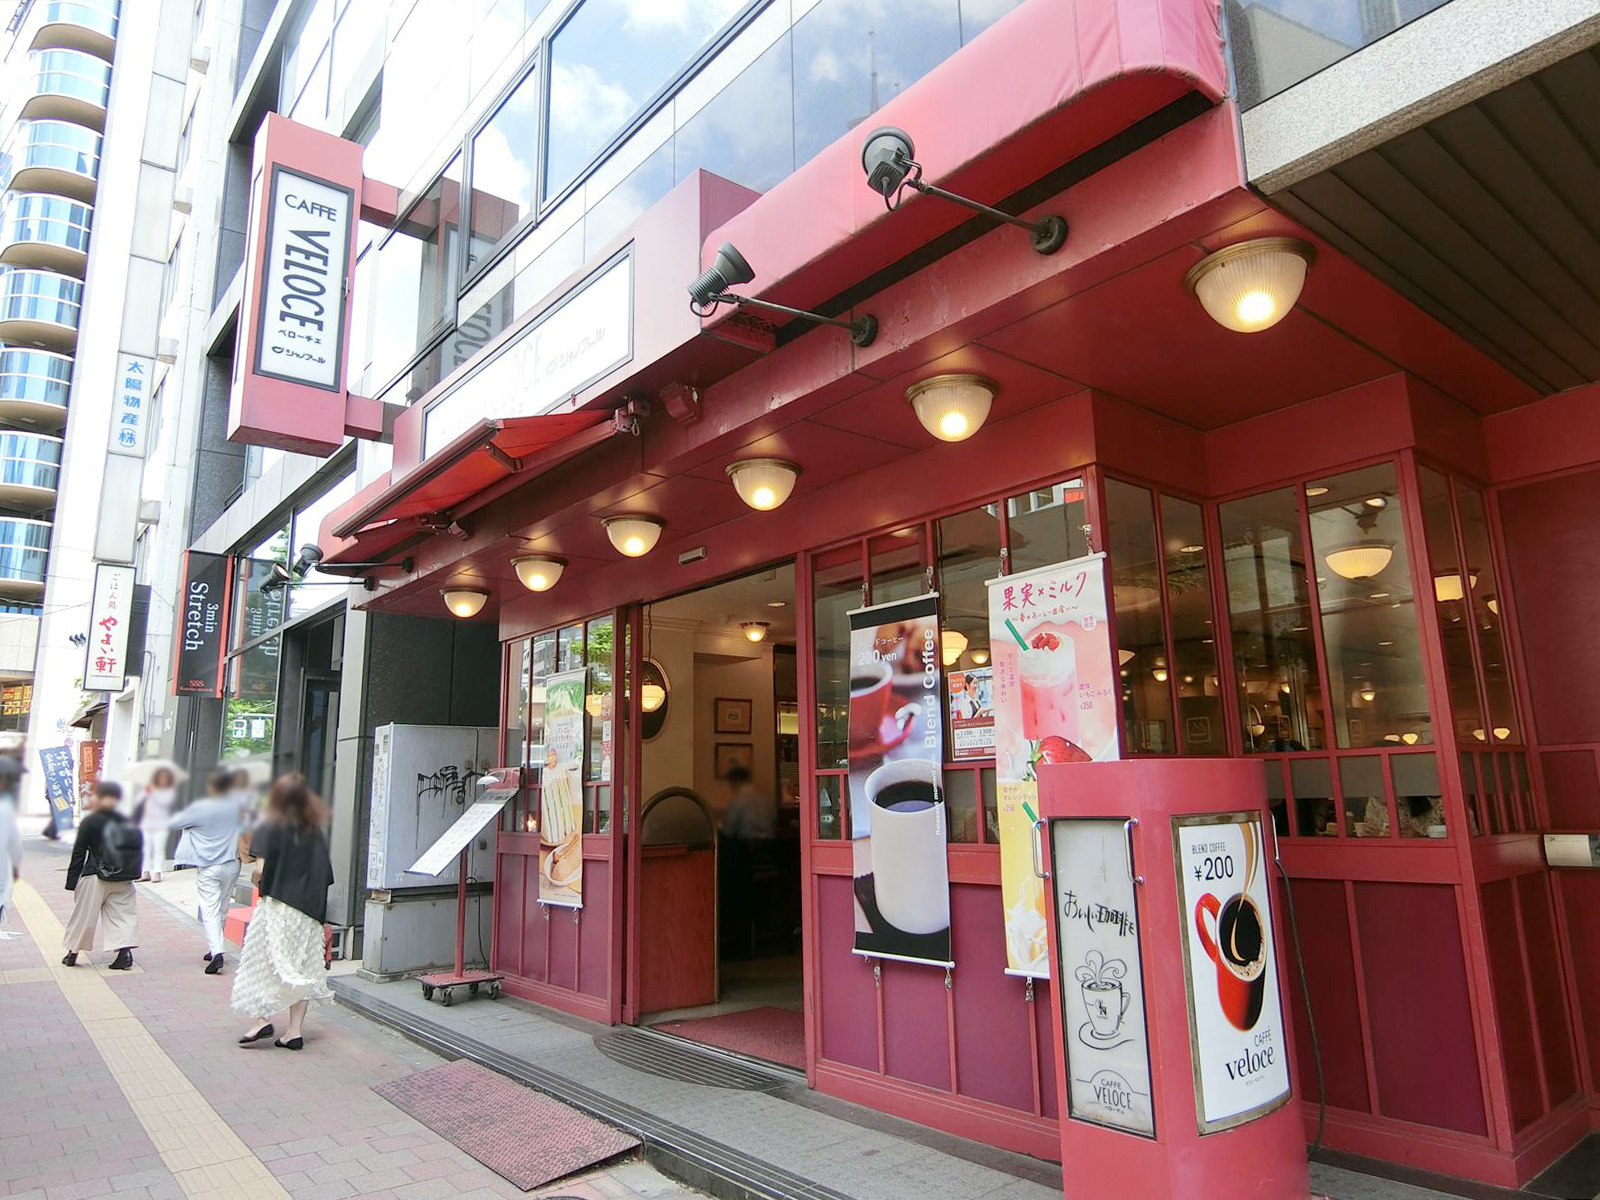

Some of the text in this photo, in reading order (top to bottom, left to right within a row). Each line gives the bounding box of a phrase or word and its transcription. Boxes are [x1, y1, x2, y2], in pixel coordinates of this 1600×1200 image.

[284, 193, 338, 223] CAFFE
[279, 229, 331, 332] VELOCE
[278, 328, 322, 345] ベローチェ
[107, 572, 121, 609] ごはん処
[185, 581, 209, 651] Stretch
[205, 602, 219, 633] 3min
[96, 615, 118, 673] やよい軒
[857, 649, 898, 667] 200 yen
[921, 628, 937, 749] Blend Coffee
[1191, 841, 1227, 855] BLEND COFFEE
[1224, 1045, 1276, 1082] veloce
[1093, 1085, 1133, 1111] VELOCE
[1100, 1078, 1122, 1091] CAFFE
